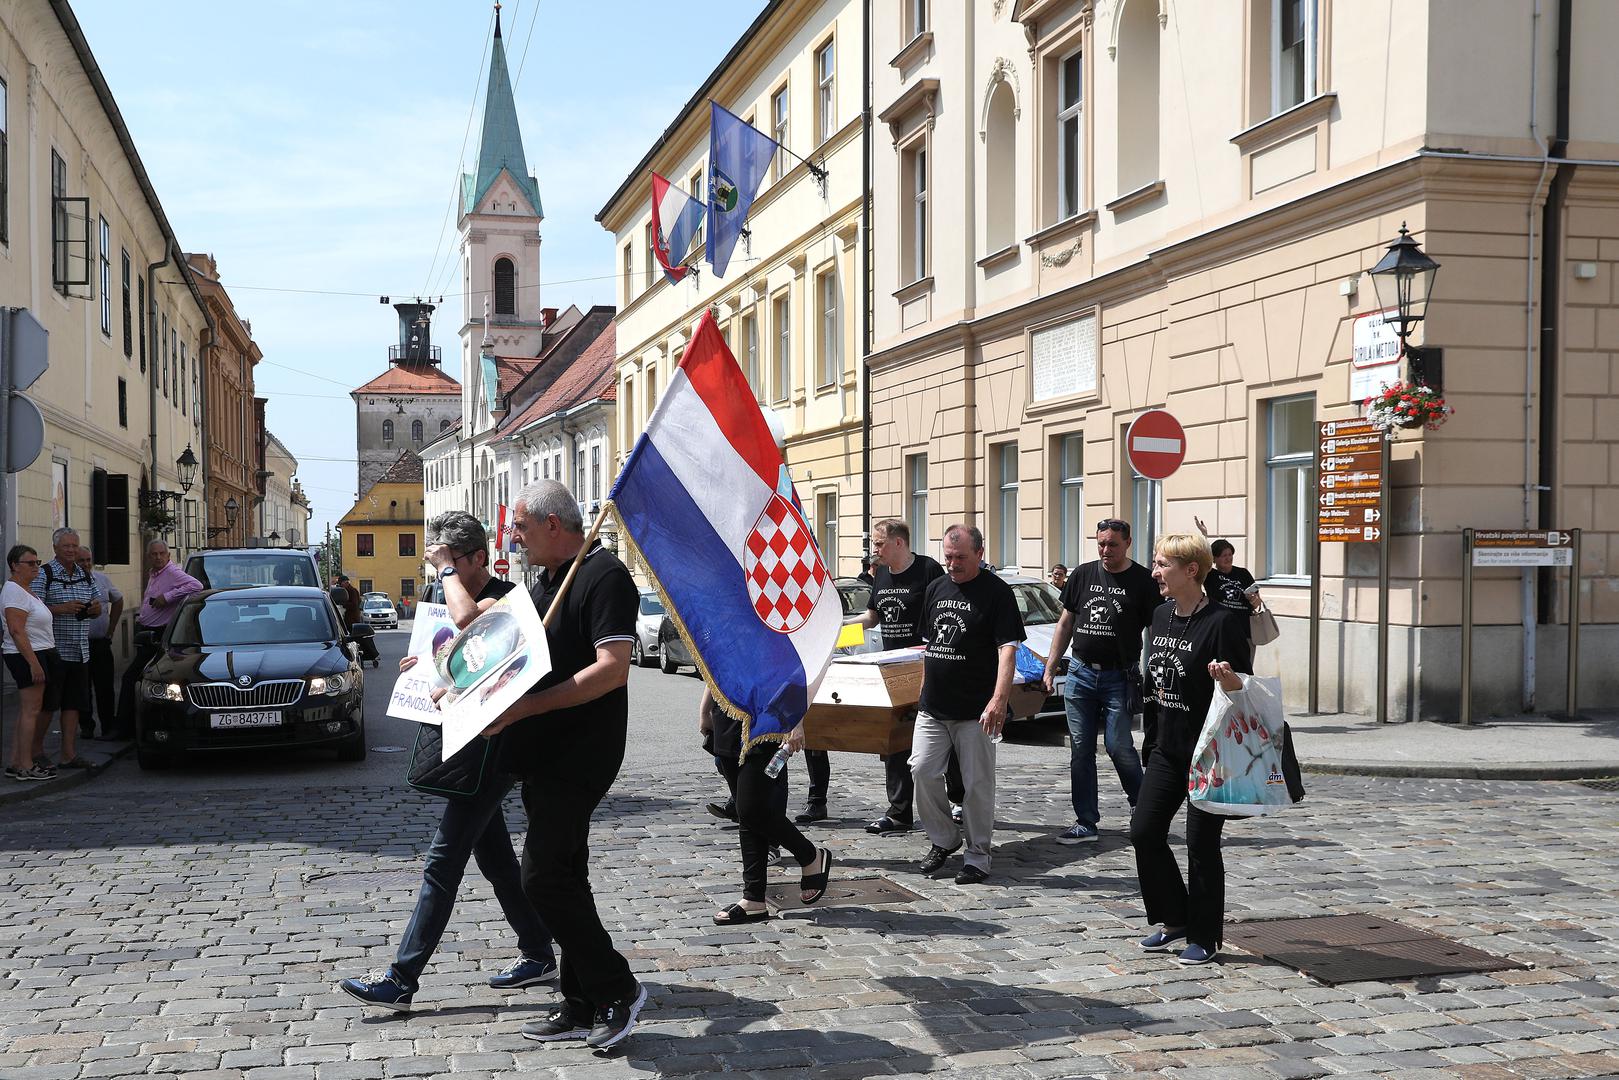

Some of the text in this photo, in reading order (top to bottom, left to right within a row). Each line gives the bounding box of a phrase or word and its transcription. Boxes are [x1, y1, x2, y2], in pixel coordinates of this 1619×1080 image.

[1501, 532, 1528, 540] povijesni
[1529, 532, 1547, 540] muzej
[1090, 585, 1126, 595] UDUGA
[936, 600, 972, 611] UDRUGA
[1173, 656, 1186, 678] VERE
[219, 714, 232, 726] ZG
